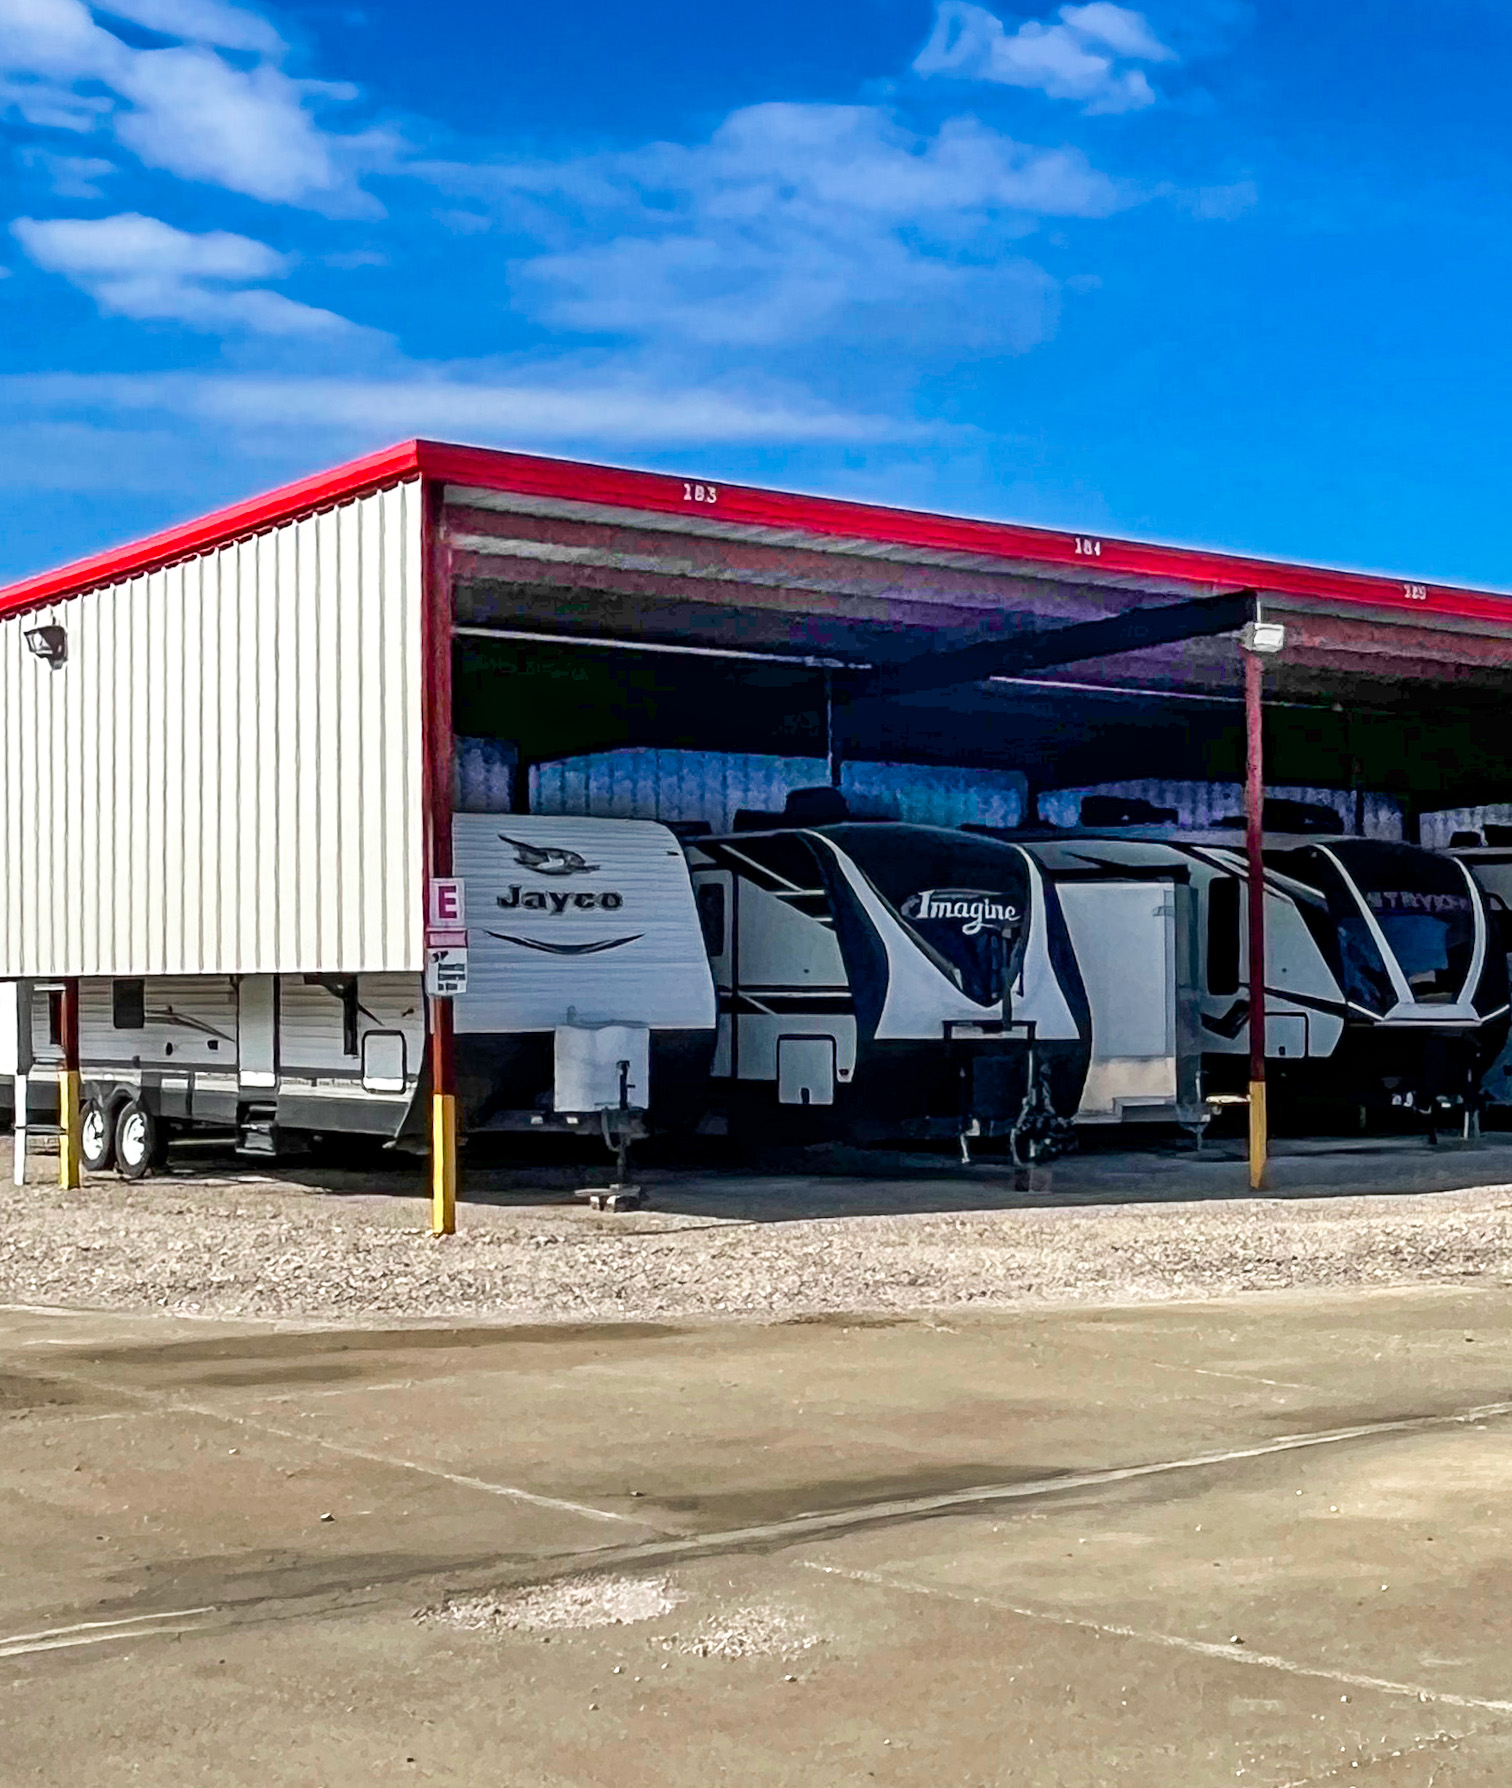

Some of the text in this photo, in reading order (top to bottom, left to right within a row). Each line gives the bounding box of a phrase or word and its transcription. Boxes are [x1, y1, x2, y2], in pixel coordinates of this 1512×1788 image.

[438, 885, 458, 919] E
[496, 883, 623, 916] Jayco
[915, 889, 1021, 936] Imagine
